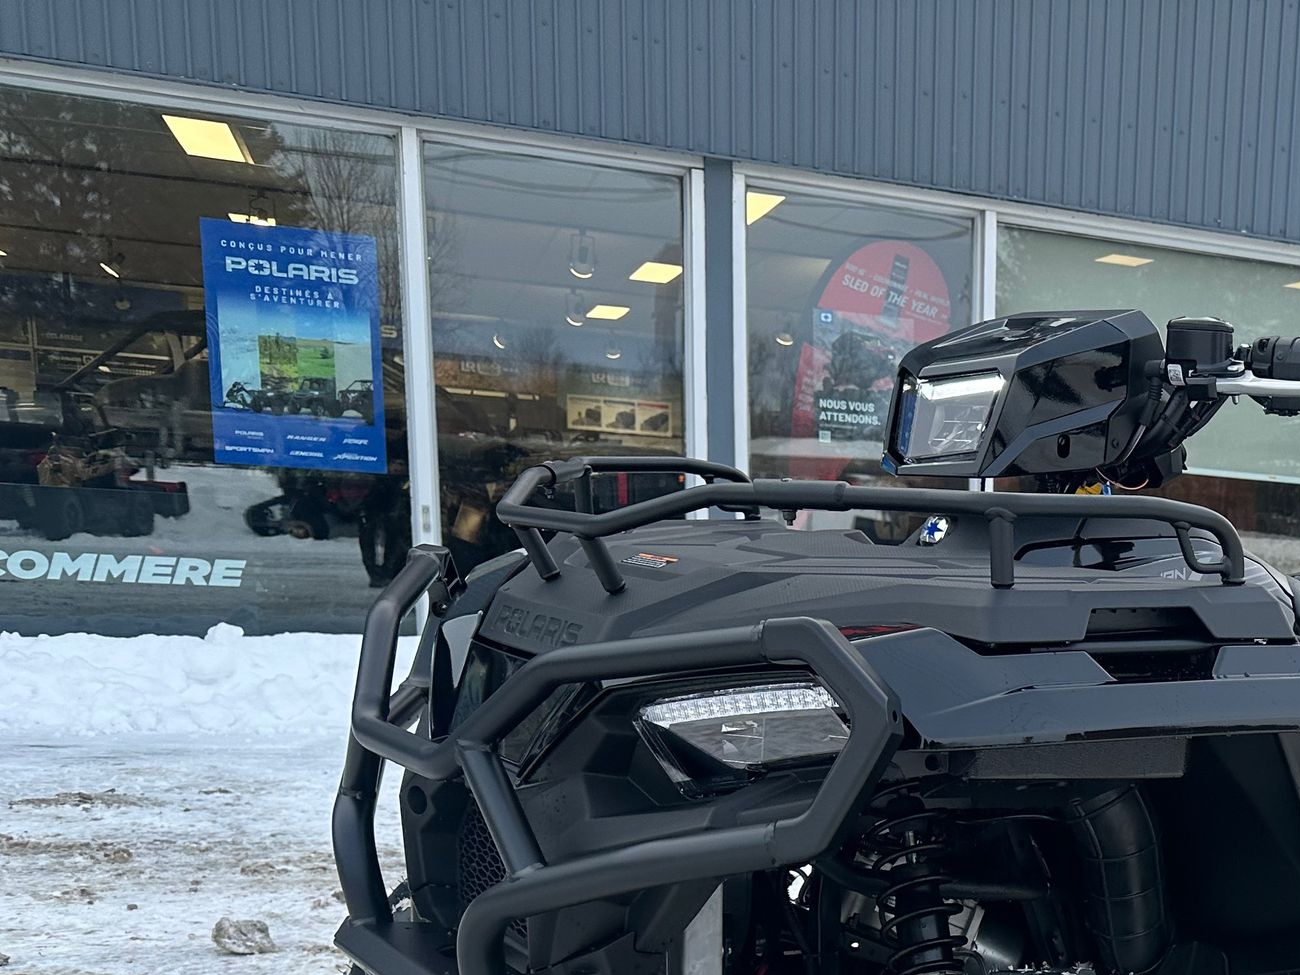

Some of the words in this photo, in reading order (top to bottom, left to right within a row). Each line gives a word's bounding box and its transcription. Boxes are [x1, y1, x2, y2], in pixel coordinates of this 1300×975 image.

[220, 239, 273, 252] CONÇUS
[280, 245, 313, 257] POUR
[320, 249, 362, 262] MENER
[225, 255, 360, 286] POLARIS
[250, 293, 340, 309] S'AVENTURER
[255, 285, 320, 299] DESTINÉS
[842, 273, 869, 293] SLED
[870, 285, 887, 298] OF
[887, 290, 909, 308] THE
[911, 299, 938, 318] YEAR
[819, 398, 847, 411] NOUS
[848, 401, 875, 413] VOUS
[819, 411, 881, 426] ATTENDONS.
[0, 550, 247, 587] OMMERE
[491, 604, 583, 647] POLARIS
